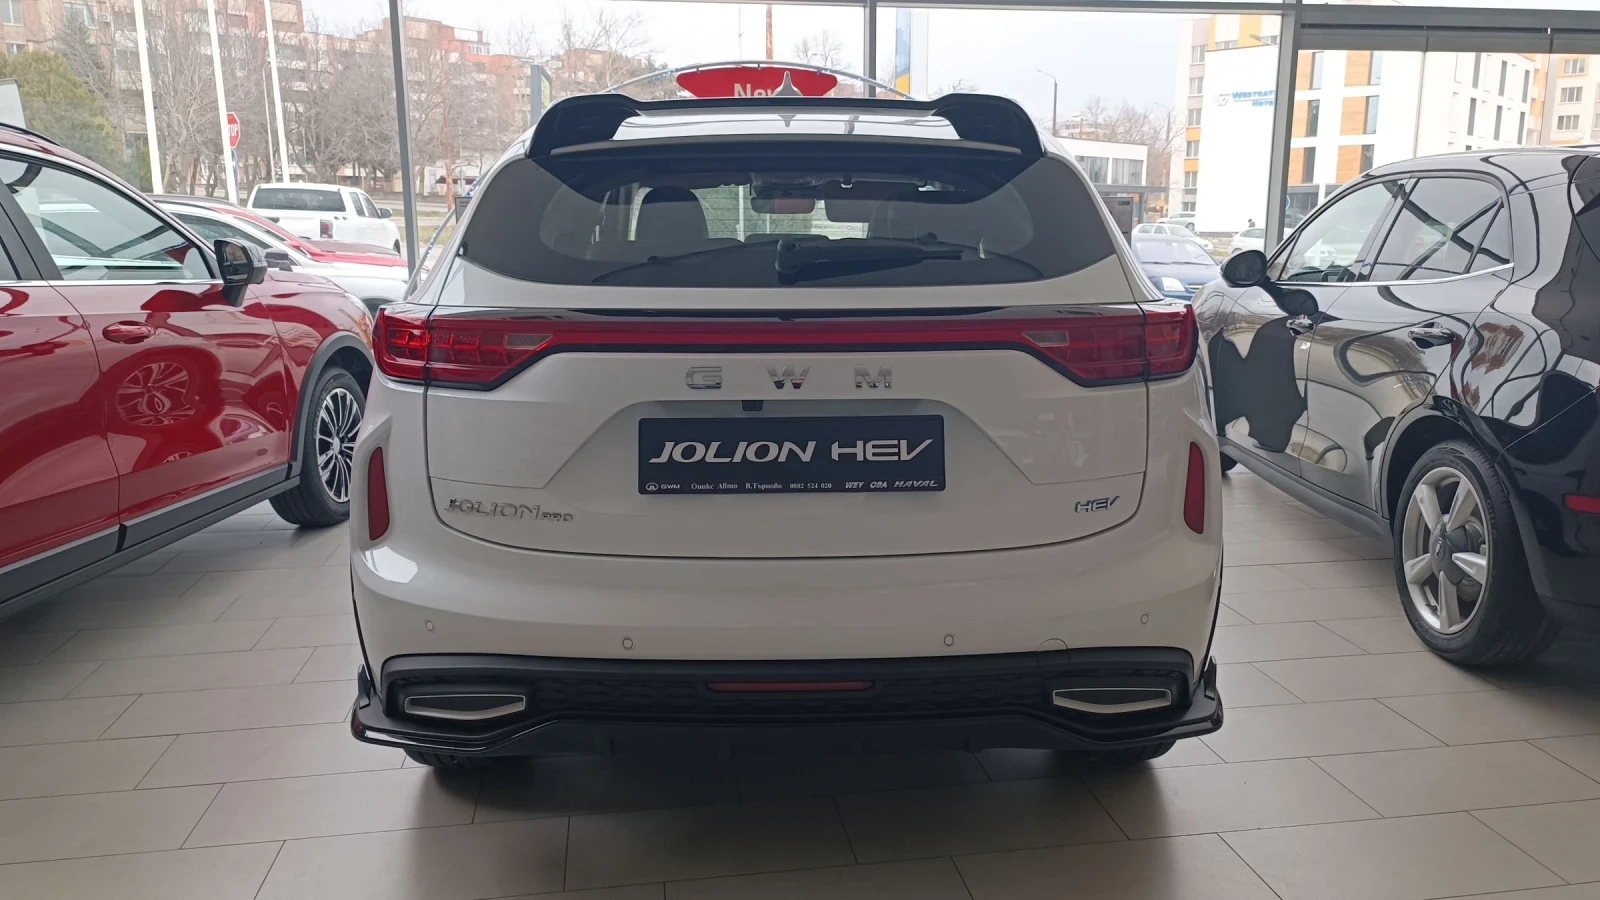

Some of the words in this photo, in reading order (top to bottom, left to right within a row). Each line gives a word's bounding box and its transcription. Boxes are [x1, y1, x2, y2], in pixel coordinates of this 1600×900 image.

[685, 365, 893, 390] GWM
[648, 441, 817, 464] JOLION
[831, 438, 934, 462] HEV
[845, 481, 865, 489] WEY
[869, 481, 888, 489] ORA
[893, 480, 939, 488] HAVAL
[444, 497, 541, 520] JOLION
[1075, 495, 1120, 513] HEV
